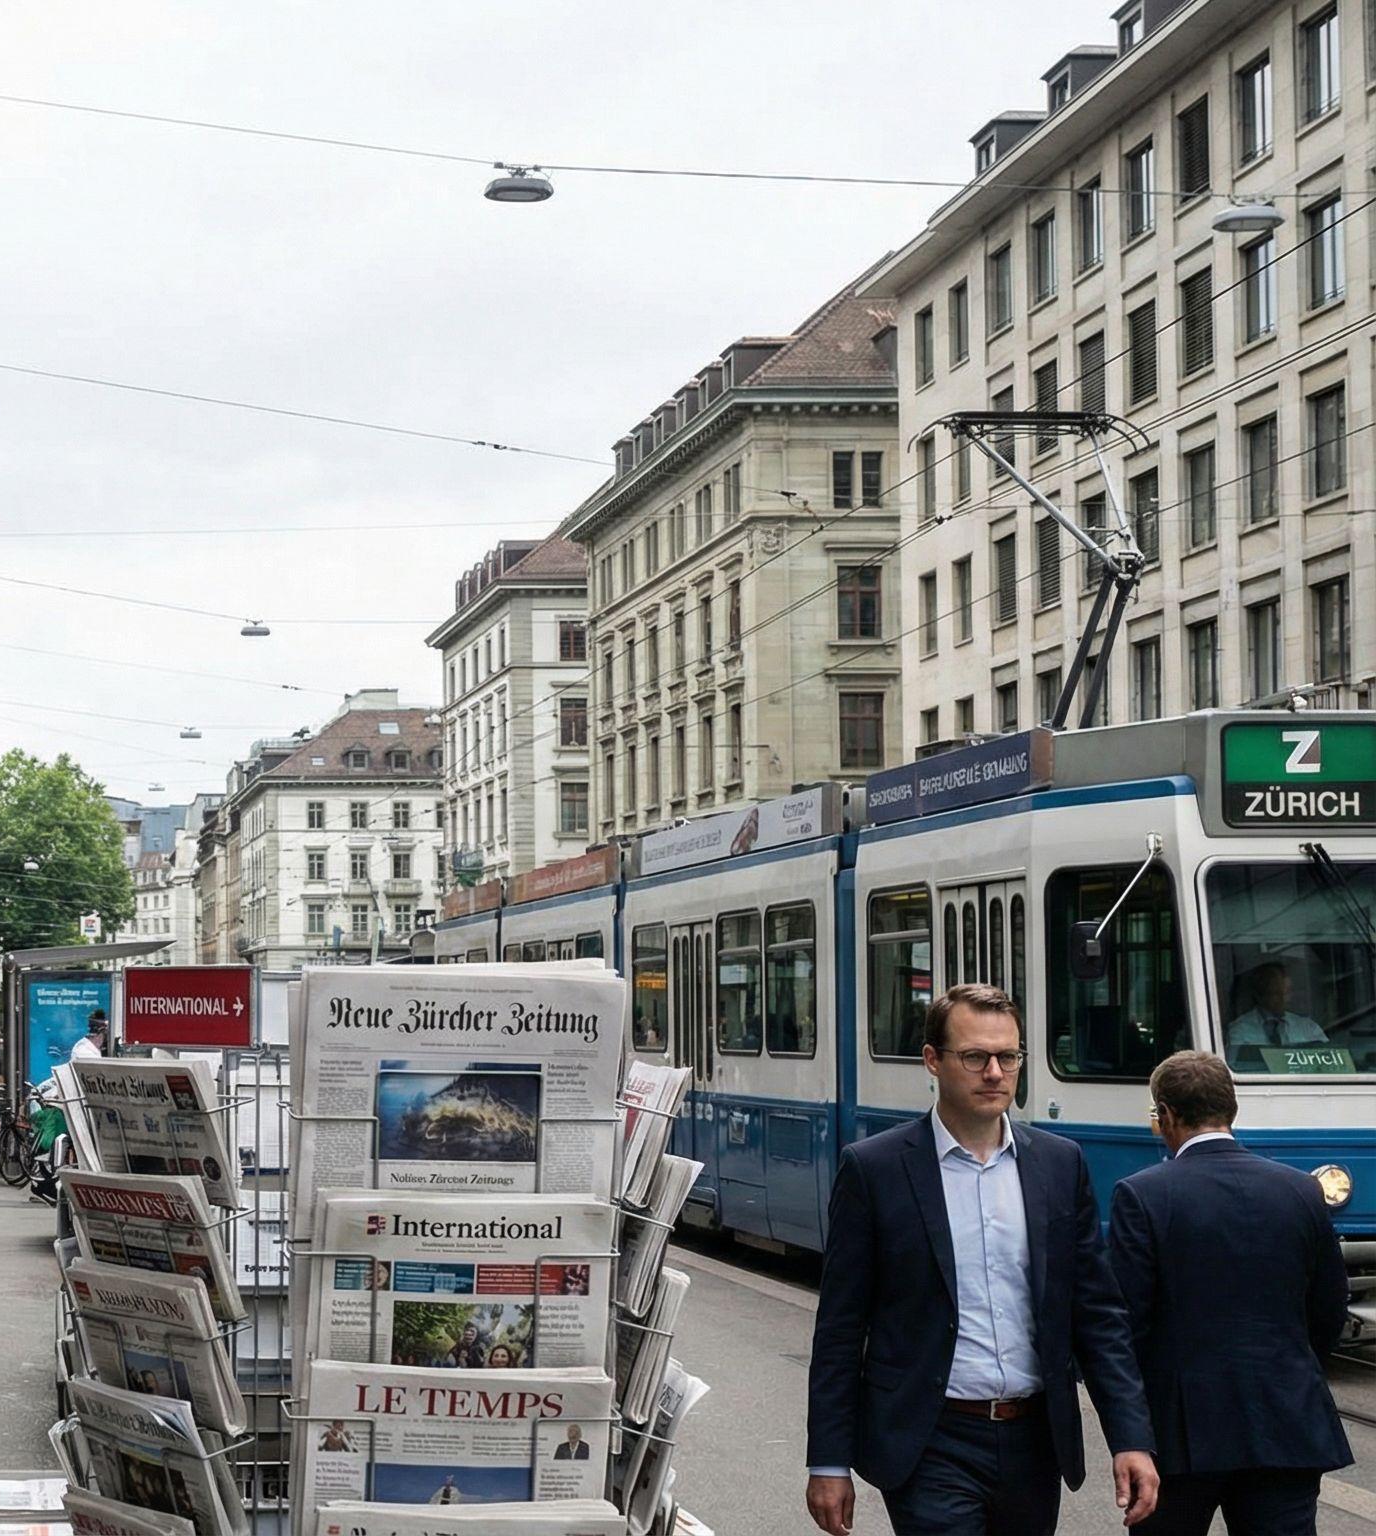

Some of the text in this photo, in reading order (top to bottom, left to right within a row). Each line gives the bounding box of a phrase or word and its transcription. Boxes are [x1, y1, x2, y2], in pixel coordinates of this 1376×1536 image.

[1282, 730, 1321, 773] Z
[1244, 785, 1360, 817] ZÜRICH
[130, 996, 229, 1015] INTERNATIONAL
[327, 997, 599, 1043] Neue Zürcher Zeitung
[391, 1214, 562, 1240] International
[354, 1384, 564, 1419] LE TEMPS
